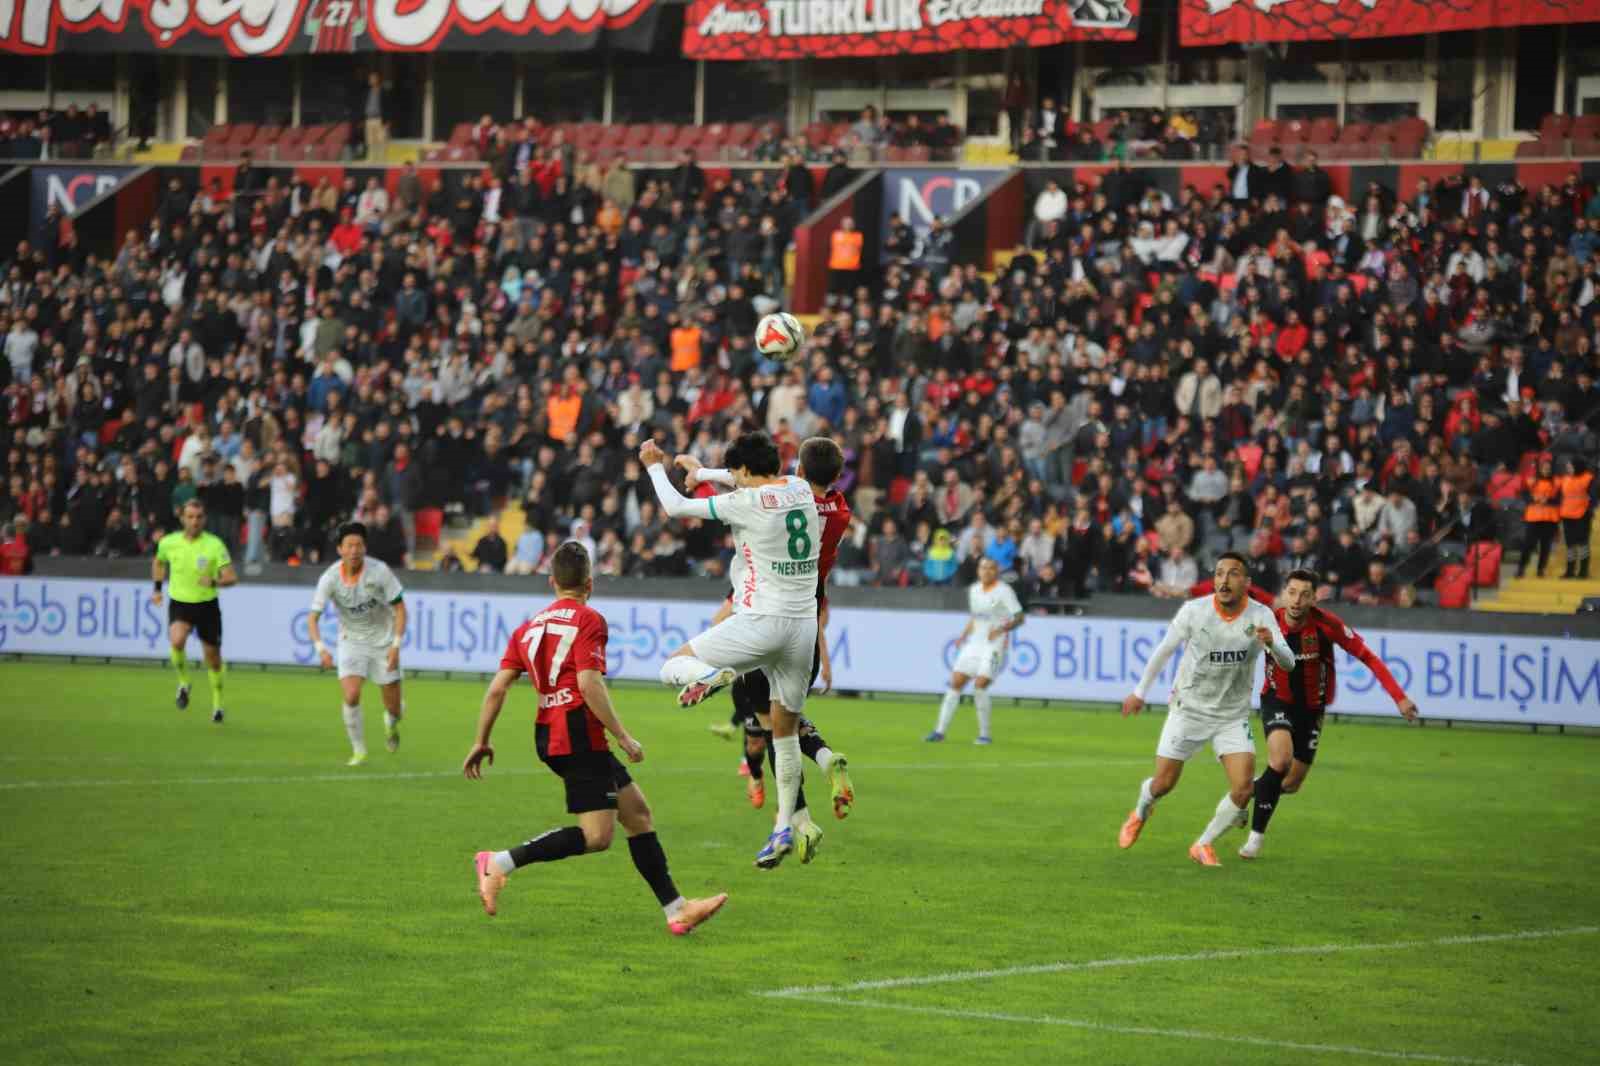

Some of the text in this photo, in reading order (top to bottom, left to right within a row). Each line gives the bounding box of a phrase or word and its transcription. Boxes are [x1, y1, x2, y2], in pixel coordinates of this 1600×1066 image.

[786, 509, 811, 560] 8
[0, 584, 66, 646] bb
[521, 623, 579, 687] 77
[1426, 643, 1600, 713] BİLİŞİM
